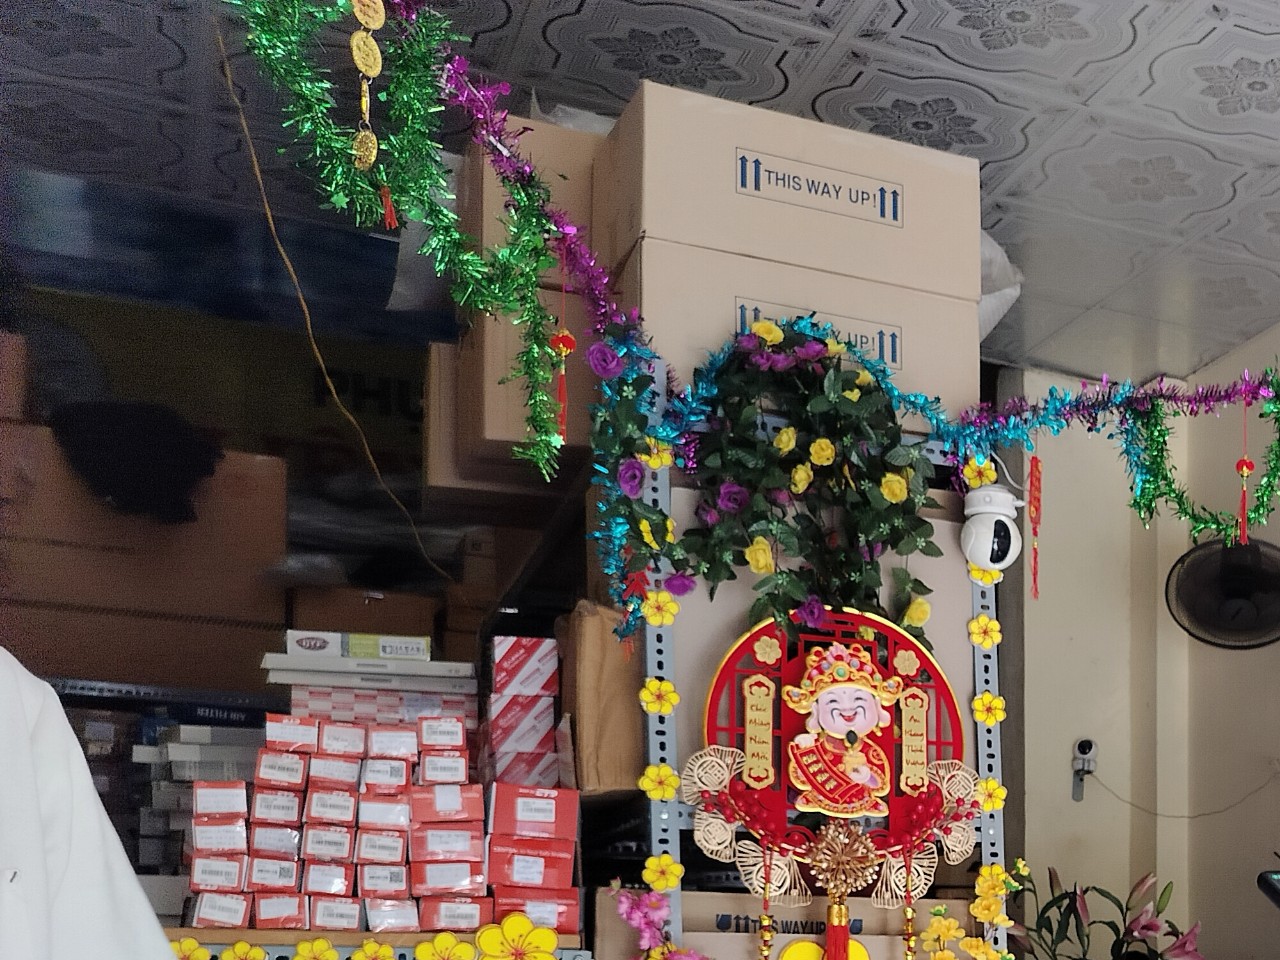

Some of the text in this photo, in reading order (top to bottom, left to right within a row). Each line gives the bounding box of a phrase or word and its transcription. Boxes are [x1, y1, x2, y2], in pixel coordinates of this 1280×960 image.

[764, 169, 877, 208] THIS WAY UP!
[750, 919, 778, 934] TS
[782, 920, 809, 934] WAY
